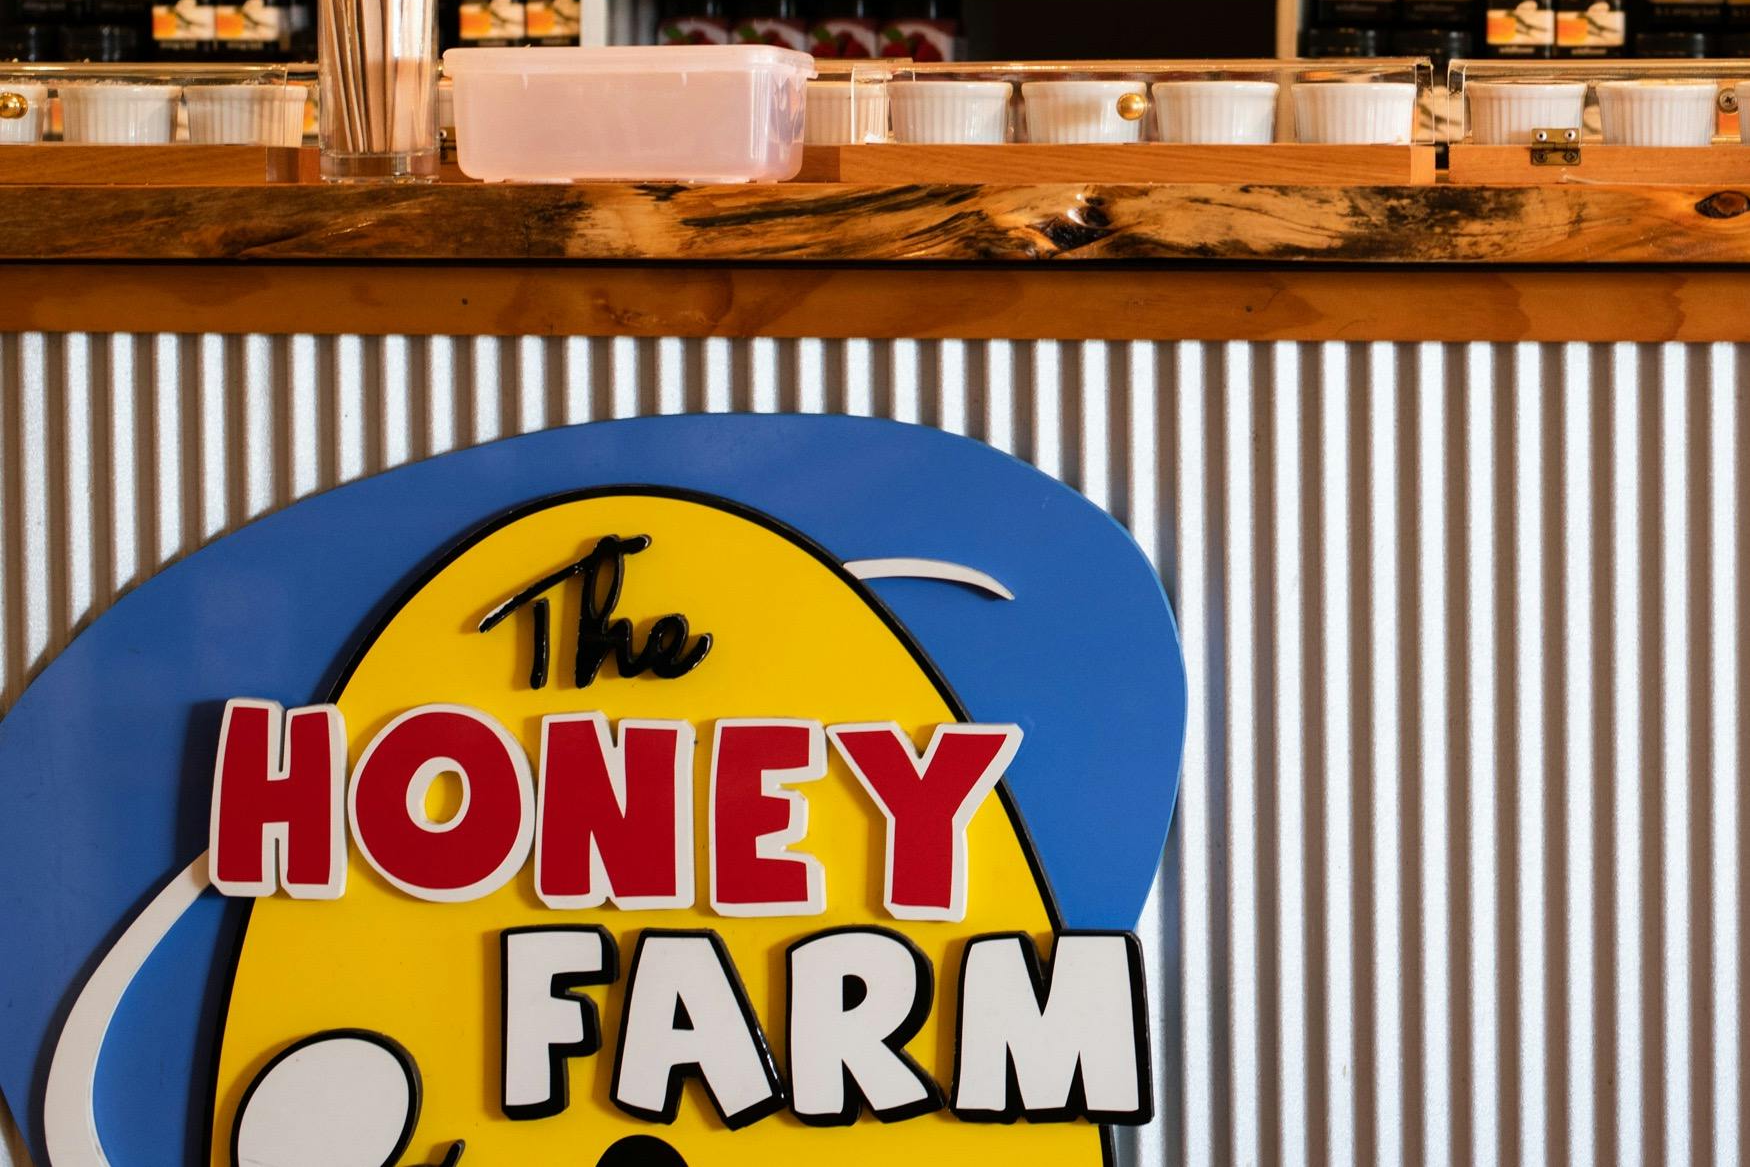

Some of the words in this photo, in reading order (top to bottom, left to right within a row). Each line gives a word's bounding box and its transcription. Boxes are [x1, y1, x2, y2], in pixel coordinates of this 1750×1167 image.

[478, 533, 716, 690] The
[208, 697, 1024, 921] HONEY
[501, 923, 1155, 1130] FARM
